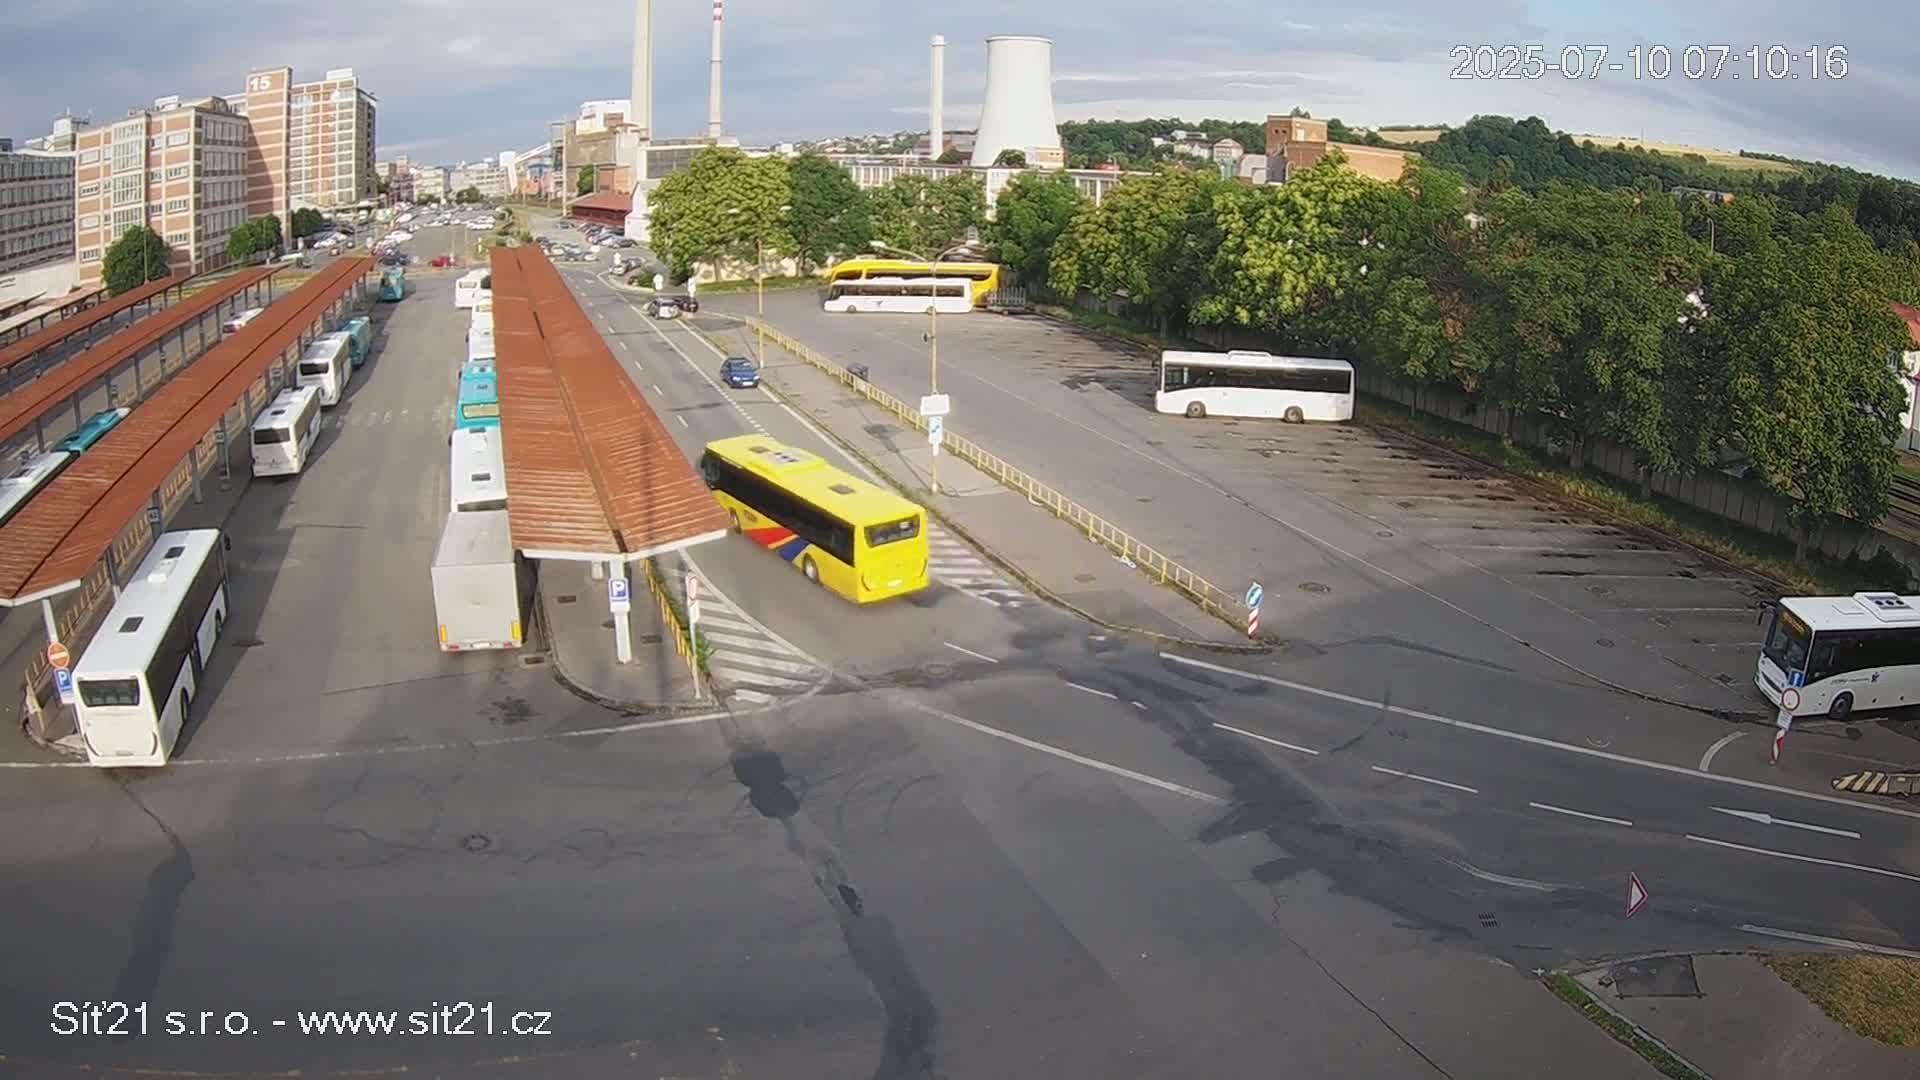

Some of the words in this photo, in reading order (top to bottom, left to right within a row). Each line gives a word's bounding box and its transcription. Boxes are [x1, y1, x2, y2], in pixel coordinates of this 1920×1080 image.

[250, 75, 271, 91] 15
[612, 581, 625, 596] P
[58, 671, 68, 686] P
